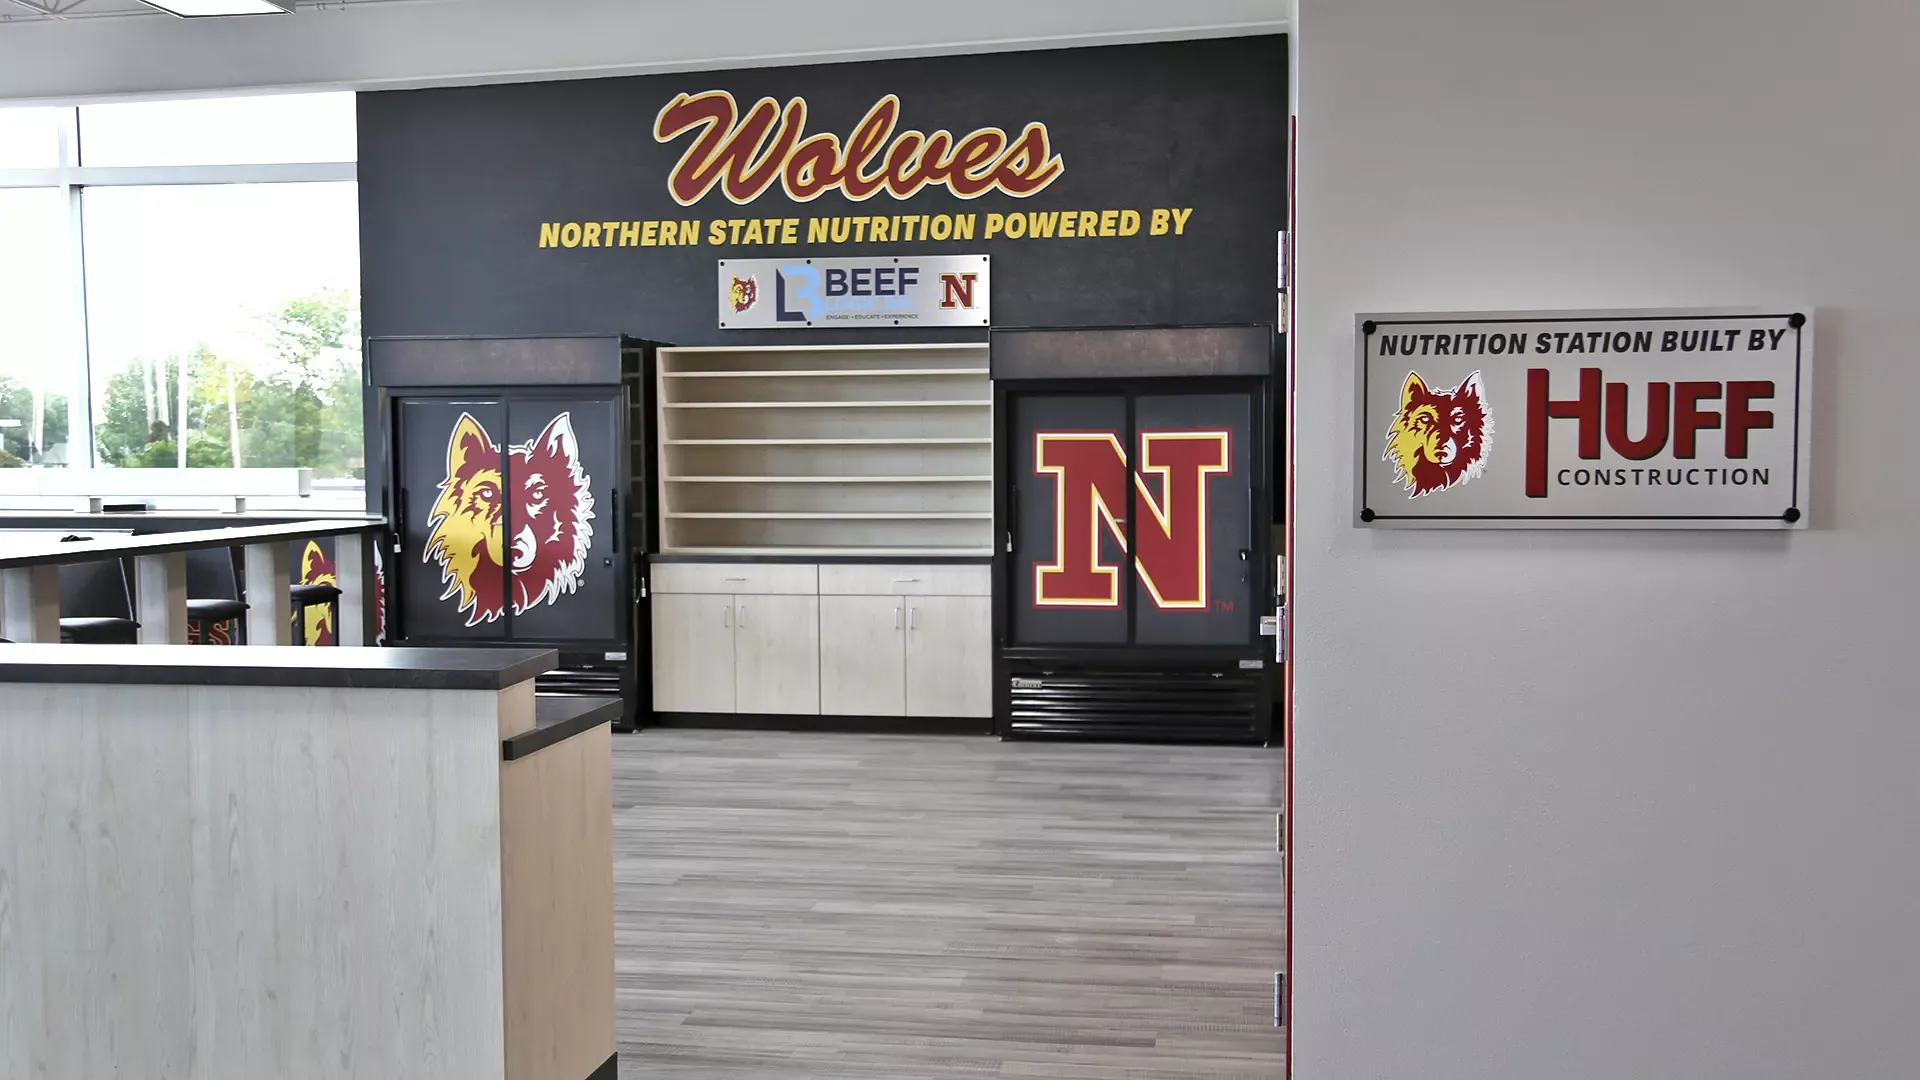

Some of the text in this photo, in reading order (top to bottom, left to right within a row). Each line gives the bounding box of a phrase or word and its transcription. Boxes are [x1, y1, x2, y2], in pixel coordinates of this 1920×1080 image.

[652, 89, 1065, 206] Wolves
[539, 208, 1193, 248] NORTHERN STATE NUTRITION POWERED BY
[825, 267, 919, 296] BEEF
[939, 272, 978, 309] N
[825, 297, 880, 311] LOGIC
[1379, 328, 1786, 356] NUTRITION STATION BUILT BY
[1525, 367, 1775, 498] HUFF
[1557, 467, 1770, 487] CONSTRUCTION
[1033, 428, 1232, 612] N
